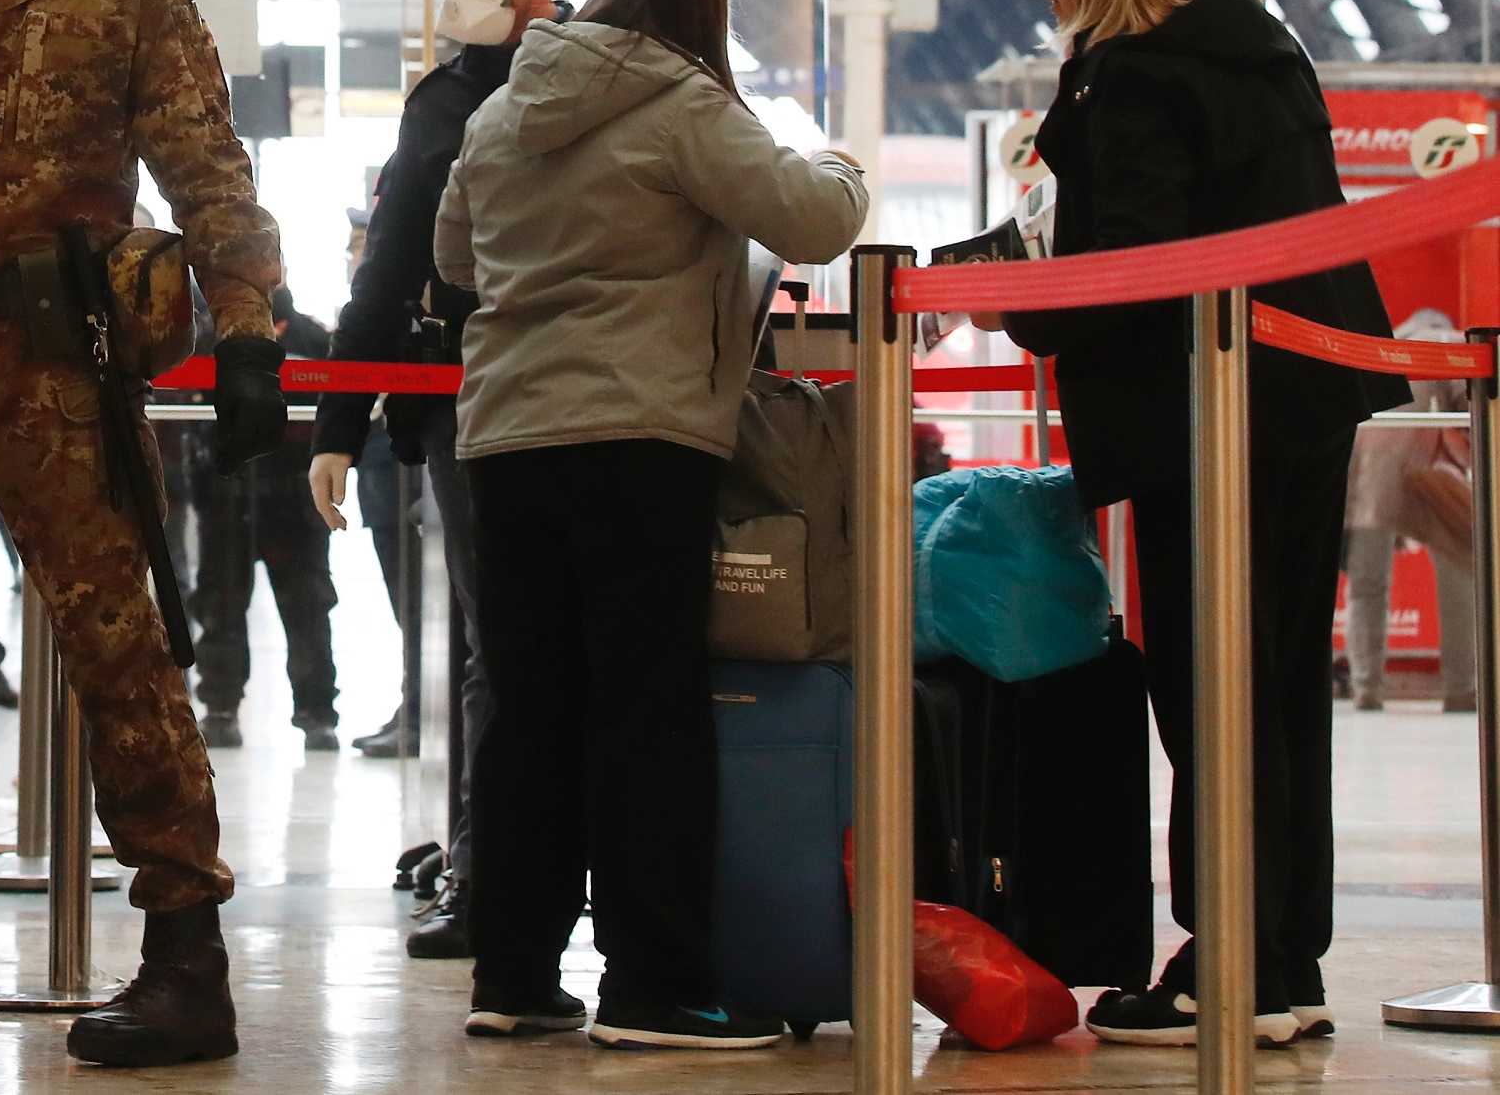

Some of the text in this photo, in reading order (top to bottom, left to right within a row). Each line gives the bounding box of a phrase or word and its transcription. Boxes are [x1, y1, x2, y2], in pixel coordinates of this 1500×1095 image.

[763, 568, 788, 580] LIFE
[714, 579, 766, 594] AND FUN
